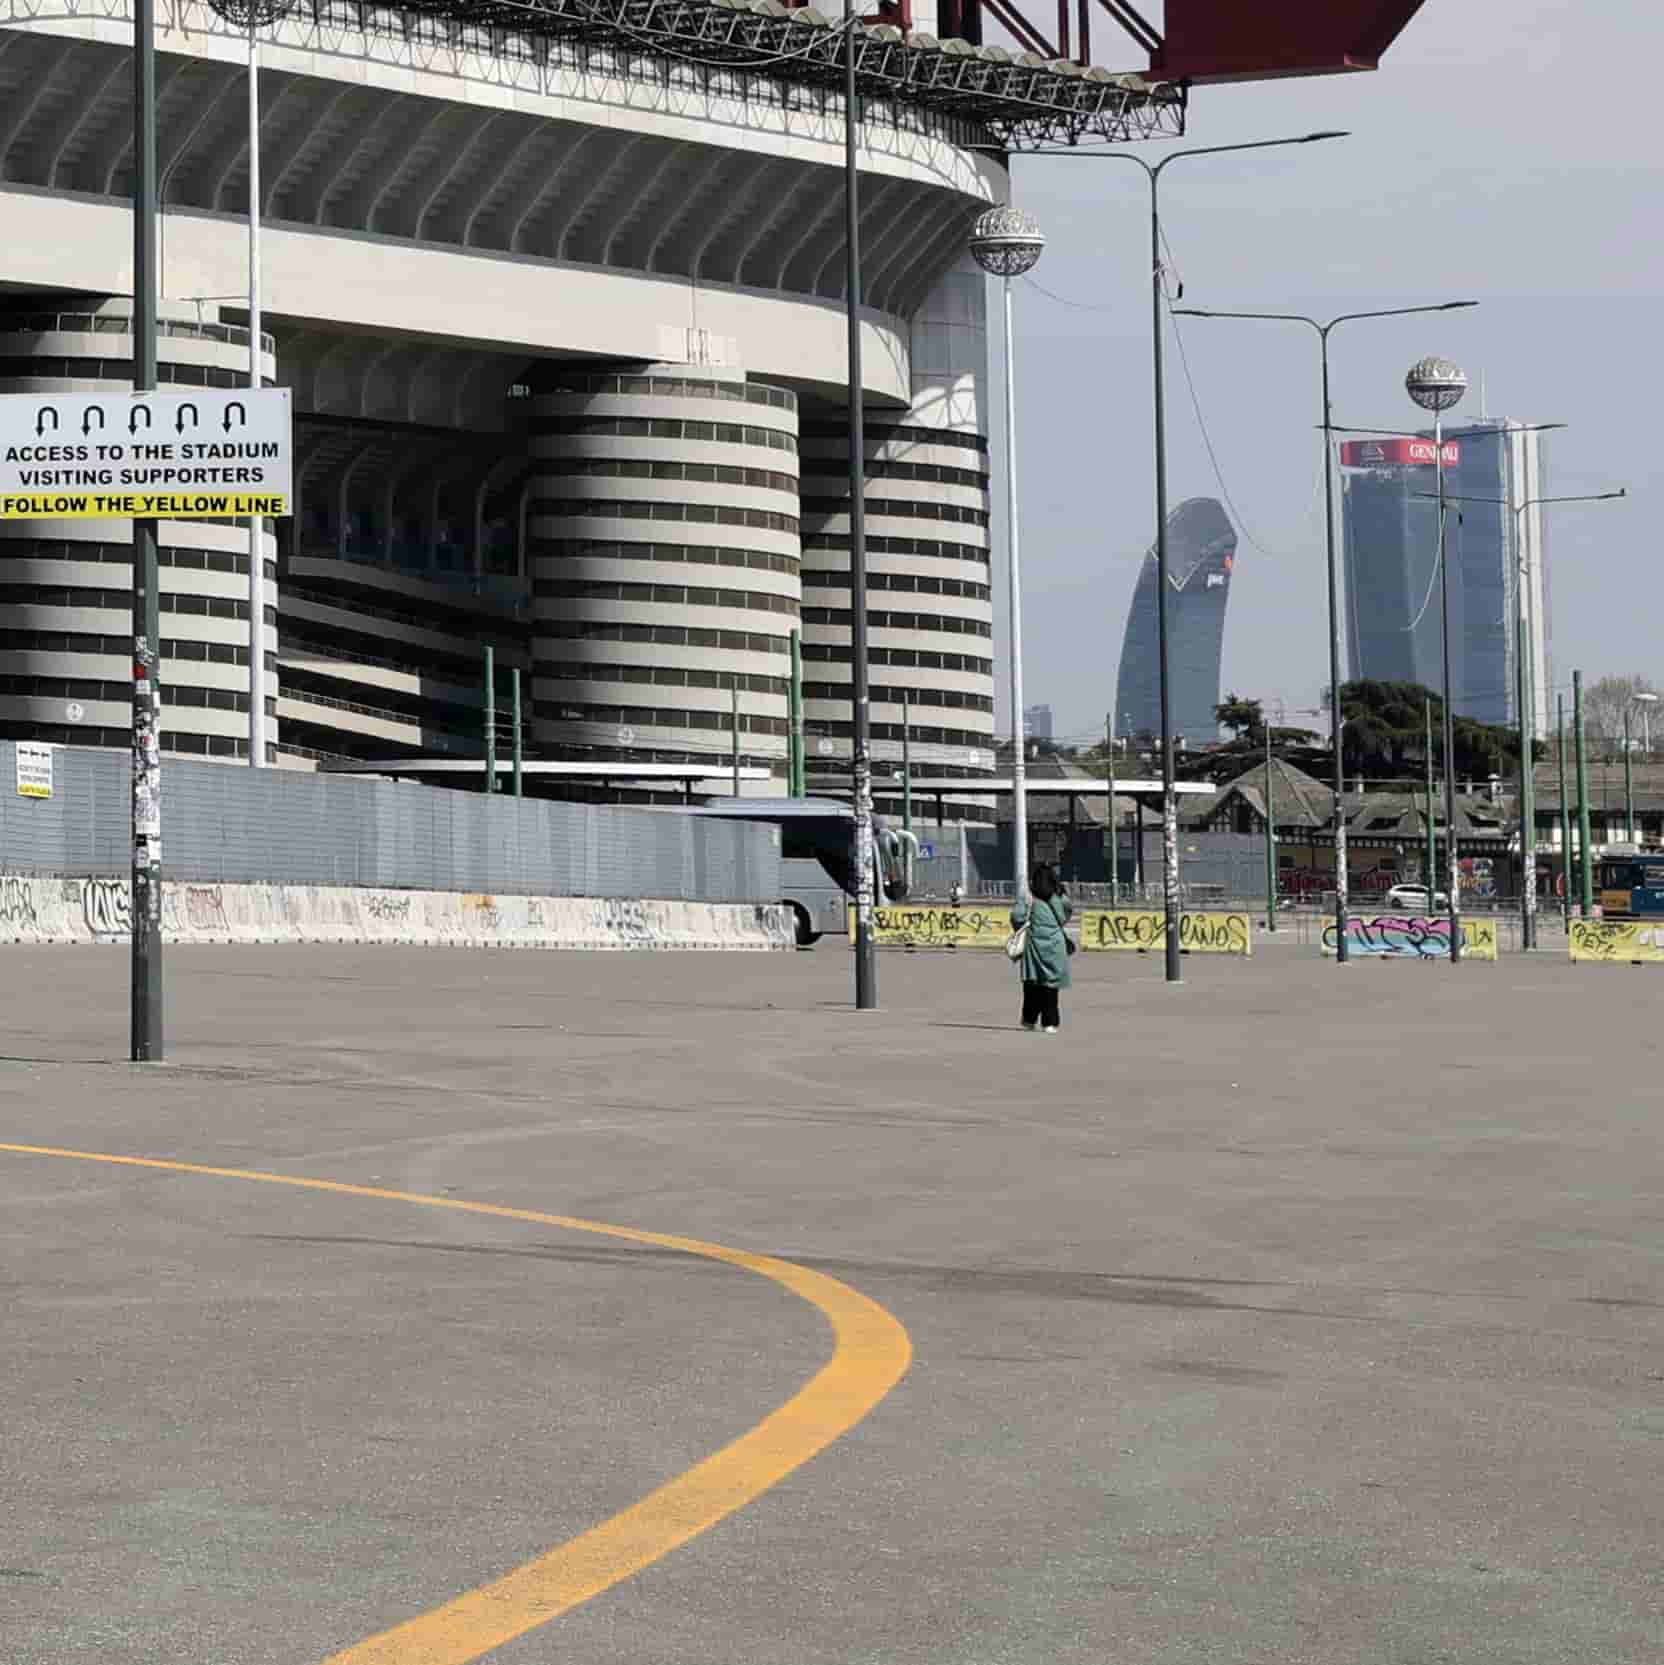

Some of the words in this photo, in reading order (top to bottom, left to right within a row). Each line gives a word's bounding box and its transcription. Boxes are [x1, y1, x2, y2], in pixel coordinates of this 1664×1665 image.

[5, 446, 89, 462] ACCESS
[95, 445, 123, 461] TO
[131, 444, 174, 459] THE
[181, 442, 279, 459] STADIUM
[18, 468, 113, 485] VISITING
[119, 466, 265, 485] SUPPORTERS
[3, 497, 88, 513] FOLLOW
[95, 497, 135, 512] THE
[143, 496, 228, 512] YELLOW
[234, 497, 283, 513] LINE
